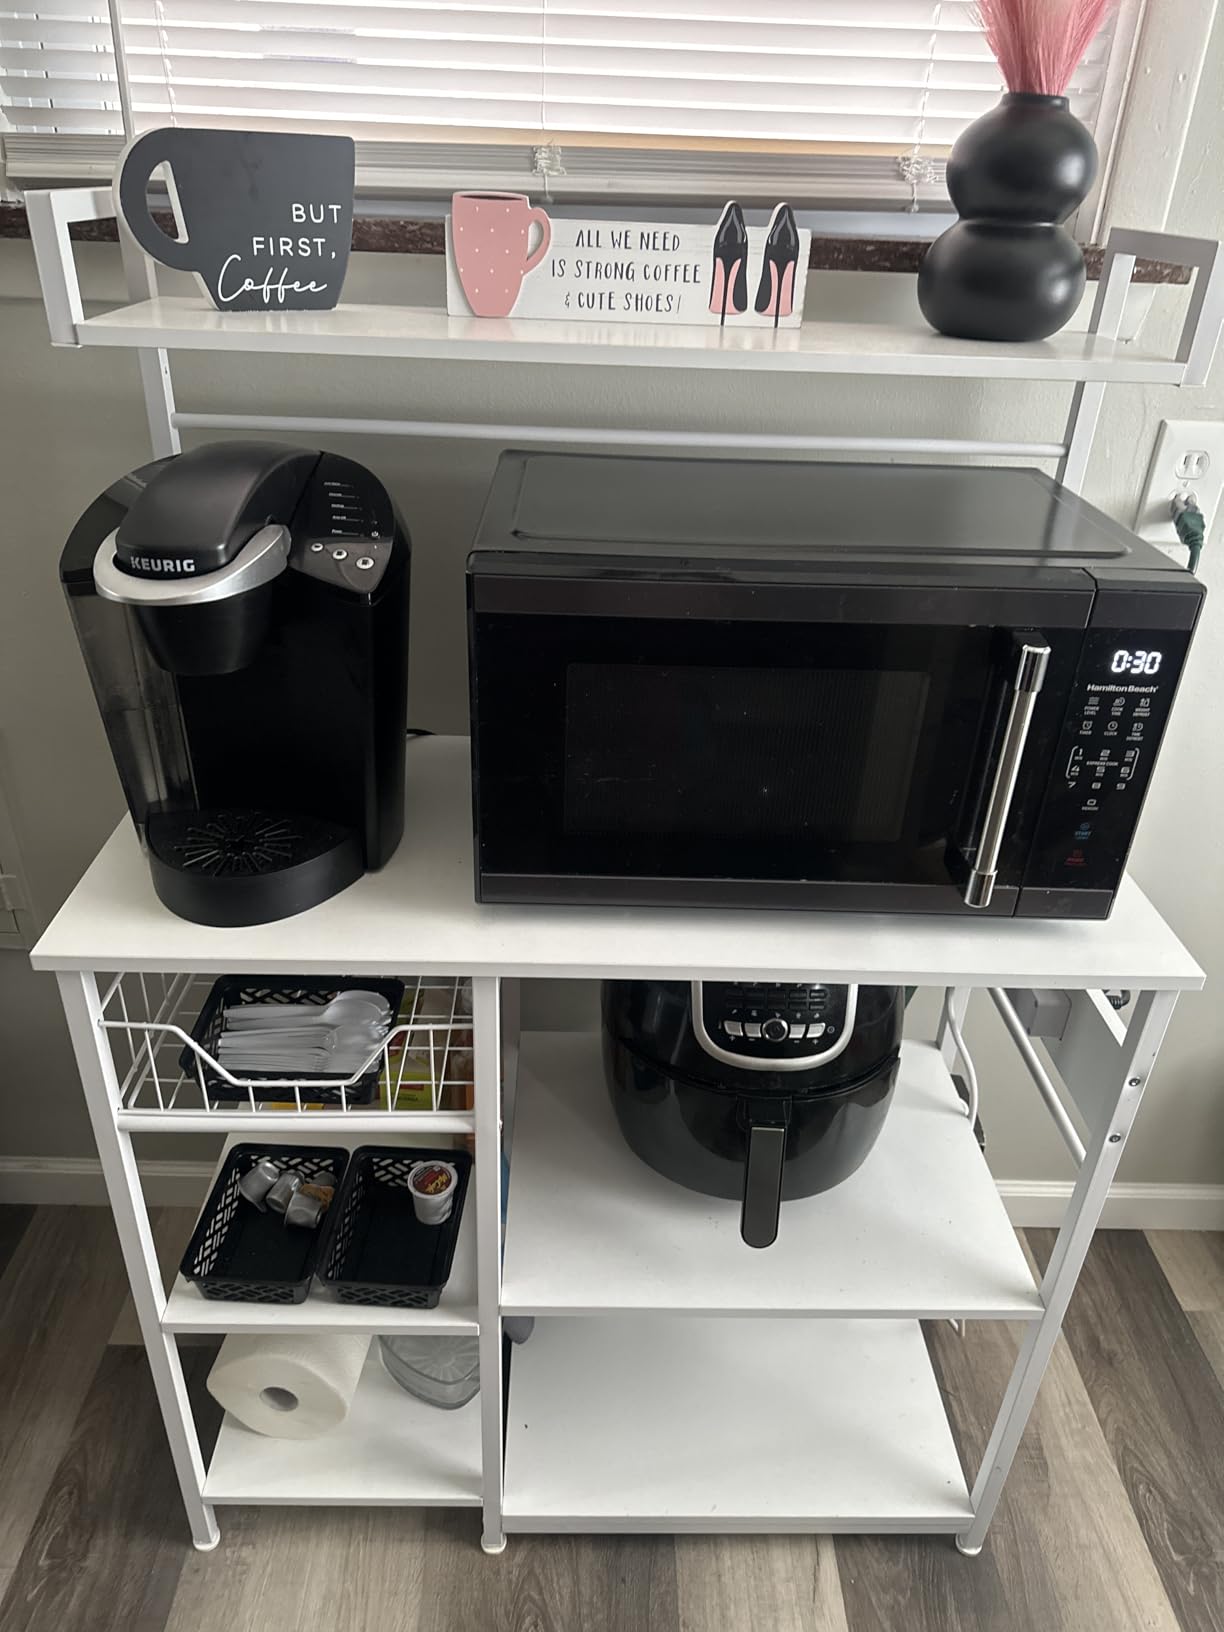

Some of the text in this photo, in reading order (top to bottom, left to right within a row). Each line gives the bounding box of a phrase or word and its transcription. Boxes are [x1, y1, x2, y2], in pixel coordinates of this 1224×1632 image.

[291, 203, 342, 223] BUT
[252, 236, 336, 259] FIRST,
[575, 229, 680, 251] ALL WE NEED
[217, 254, 328, 304] Coffee
[552, 258, 701, 284] IS STRONG COFFEE
[577, 291, 616, 310] CUTE
[130, 556, 196, 572] KEURIG
[1111, 650, 1162, 674] 0:30
